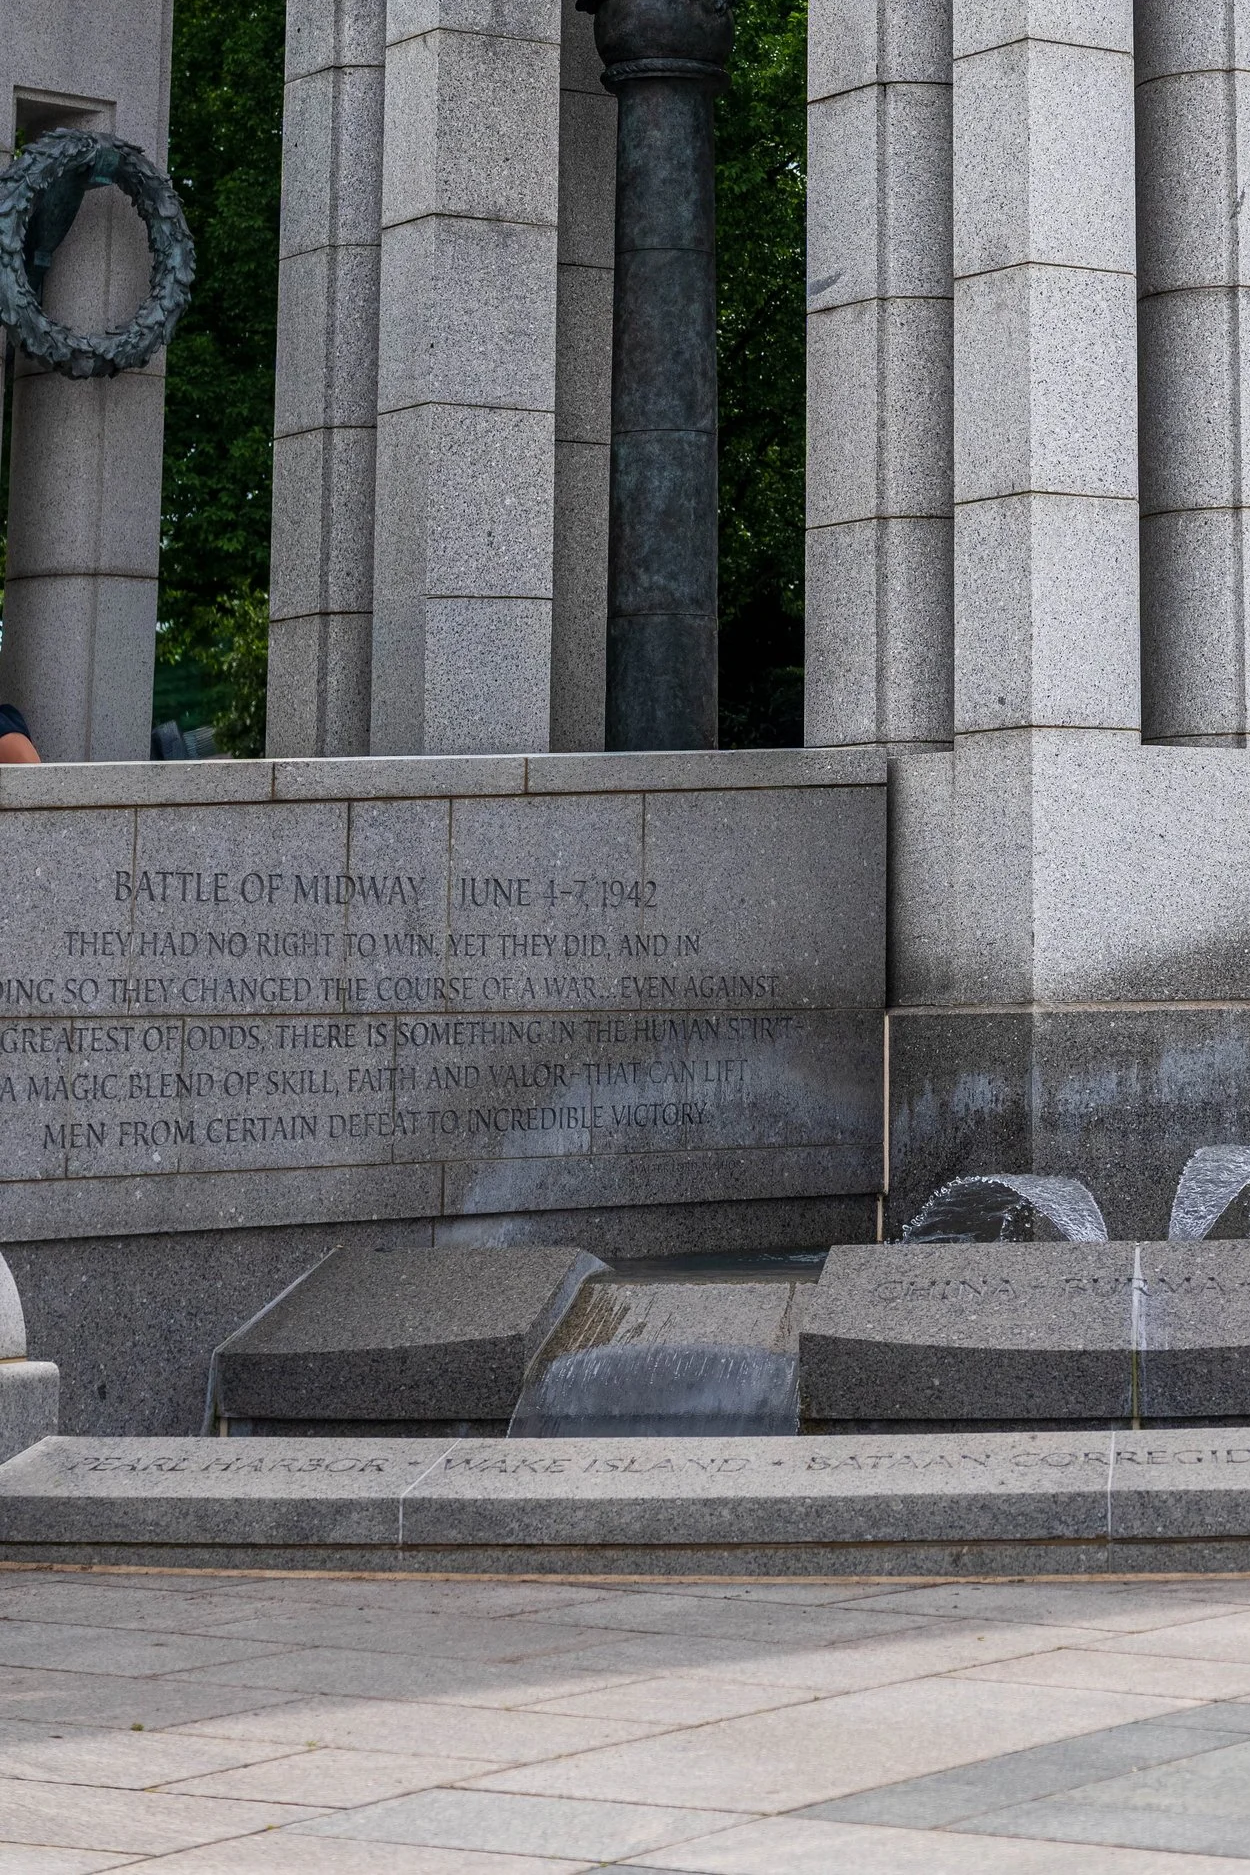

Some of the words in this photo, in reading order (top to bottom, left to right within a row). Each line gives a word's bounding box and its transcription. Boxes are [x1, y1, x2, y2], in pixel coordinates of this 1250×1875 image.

[114, 870, 230, 903] BATTLE
[240, 873, 283, 904] OF
[293, 875, 425, 906] MIDWAY
[459, 877, 531, 907] JUNE
[601, 880, 658, 909] 1942
[64, 931, 133, 957] THEY
[140, 931, 198, 957] HAD
[208, 932, 248, 958] NO
[257, 932, 335, 957] RIGHT
[343, 933, 376, 957] TO
[448, 933, 490, 957] YET
[498, 934, 559, 957] THEY
[564, 934, 611, 961] DID,
[618, 934, 669, 957] AND
[677, 934, 701, 957] IN
[63, 978, 100, 1004] SO
[108, 978, 175, 1003] THEY
[181, 977, 311, 1003] CHANGED
[321, 977, 368, 1002] THE
[377, 977, 474, 1001] COURSE
[482, 977, 515, 1000] OF
[522, 977, 536, 1000] A
[684, 975, 779, 999] AGAINST
[1, 1026, 135, 1053] GREATEST
[143, 1026, 180, 1052] OF
[187, 1026, 266, 1054] ODDS,
[276, 1023, 356, 1051] THERE
[367, 1023, 388, 1048] IS
[396, 1021, 542, 1047] SOMETHING
[551, 1021, 575, 1045] IN
[583, 1019, 627, 1043] THE
[634, 1018, 720, 1043] HUMAN
[1, 1077, 17, 1102] A
[27, 1075, 117, 1103] MAGIC
[129, 1072, 214, 1101] BLEND
[223, 1072, 259, 1097] OF
[267, 1069, 339, 1097] SKILL,
[348, 1068, 416, 1093] FAITH
[426, 1066, 480, 1091] AND
[649, 1060, 695, 1084] CAN
[703, 1059, 748, 1083] LIFT
[43, 1121, 105, 1149] MEN
[118, 1119, 196, 1147] FROM
[206, 1115, 317, 1144] CERTAIN
[328, 1111, 422, 1138] DEFEAT
[427, 1110, 459, 1135] TO
[468, 1106, 603, 1132] INCREDIBLE
[874, 1278, 1018, 1303] CHINA
[1064, 1275, 1226, 1299] BURMA
[66, 1456, 188, 1474] PEARL
[200, 1457, 390, 1474] HARBOR
[442, 1457, 572, 1475] WAKE
[582, 1456, 752, 1475] ISLAND
[804, 1452, 993, 1472] BATAAN
